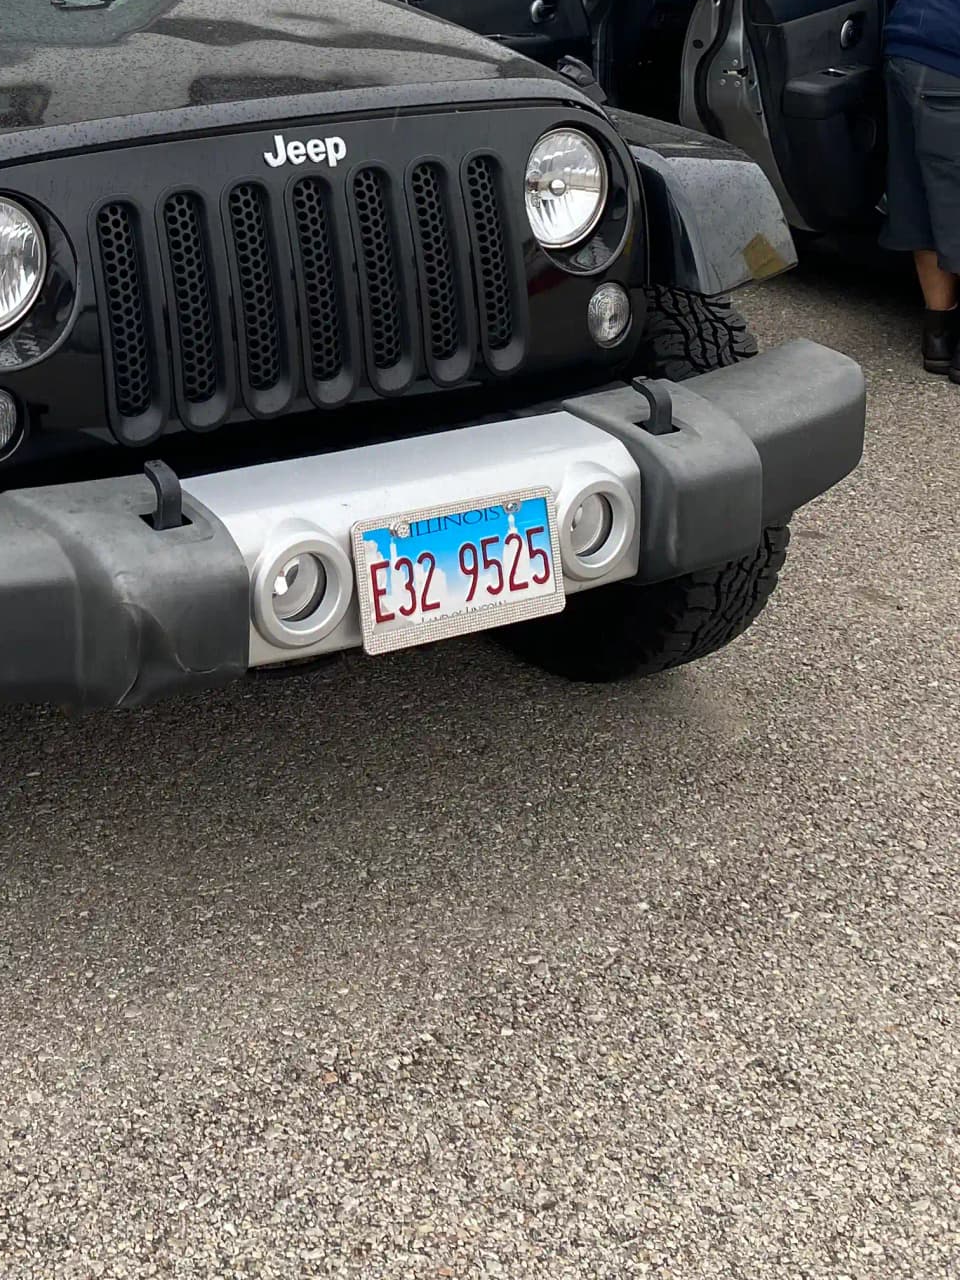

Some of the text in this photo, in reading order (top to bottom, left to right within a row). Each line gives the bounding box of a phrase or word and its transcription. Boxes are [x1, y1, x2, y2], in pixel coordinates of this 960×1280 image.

[263, 134, 347, 168] Jeep
[408, 507, 500, 537] ILLINOIS
[370, 526, 551, 624] E32 9525
